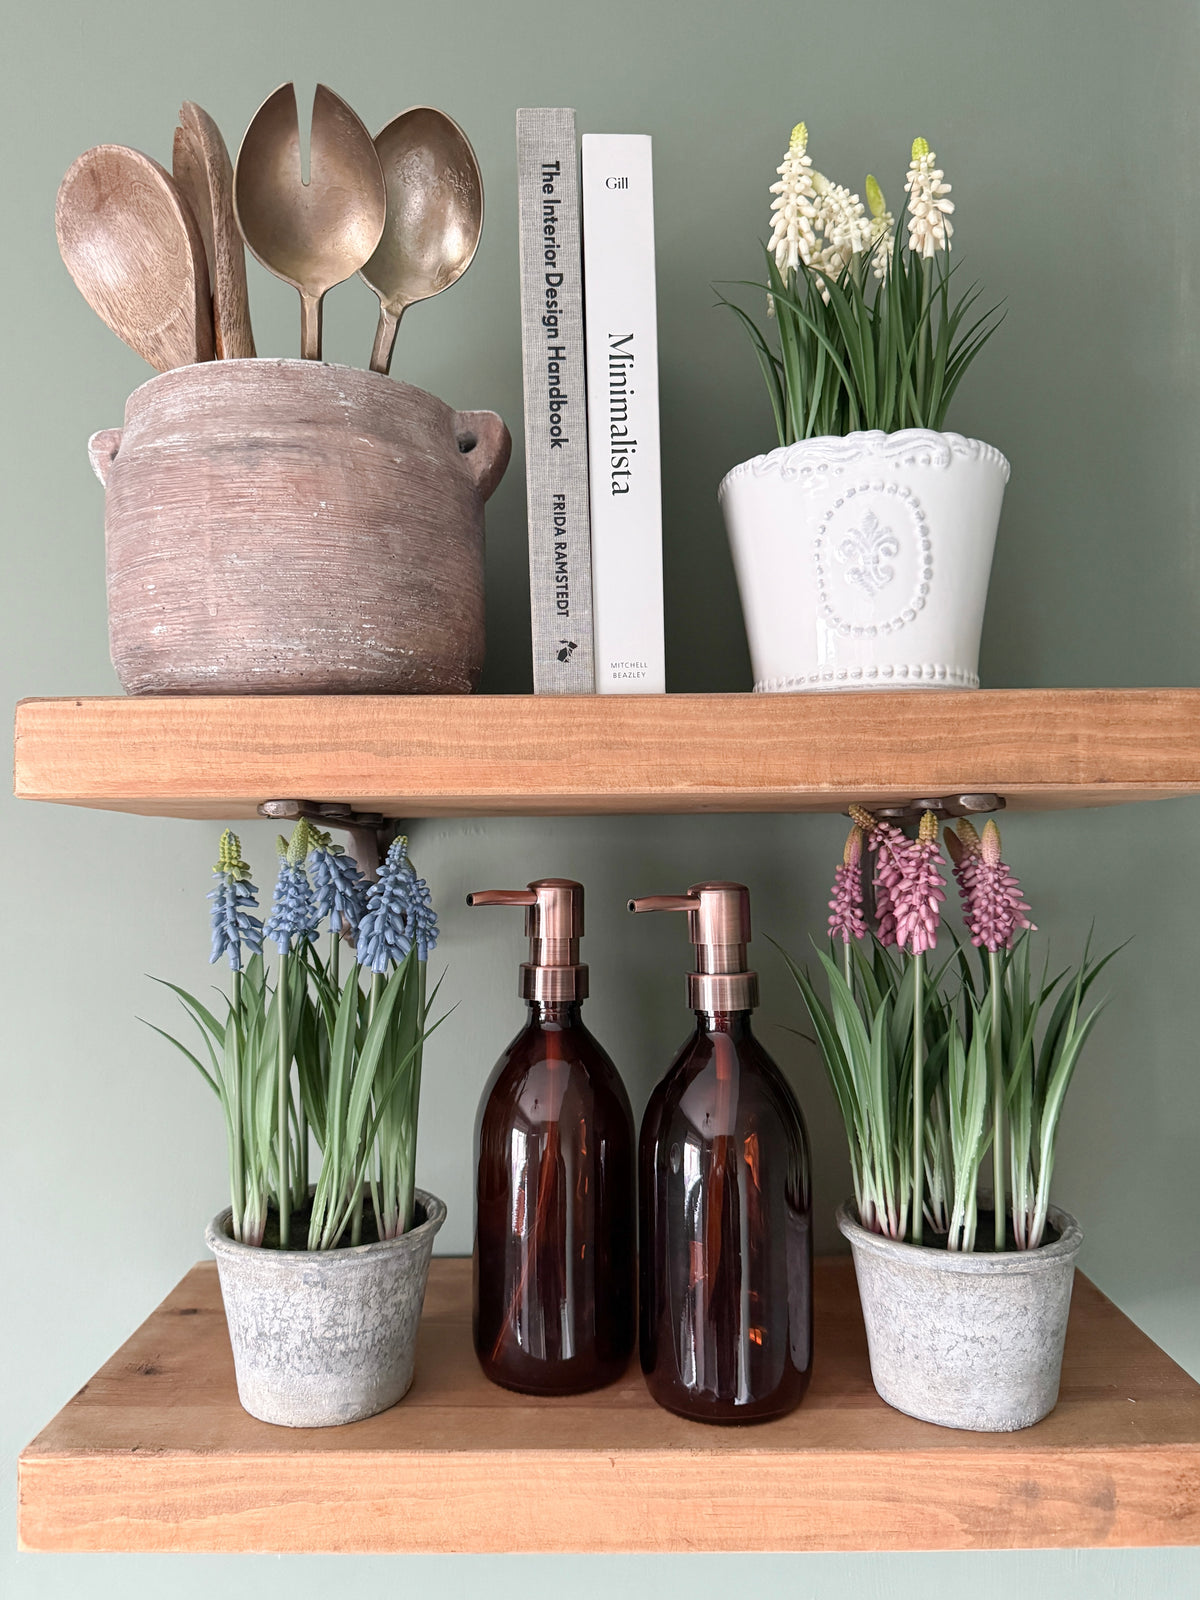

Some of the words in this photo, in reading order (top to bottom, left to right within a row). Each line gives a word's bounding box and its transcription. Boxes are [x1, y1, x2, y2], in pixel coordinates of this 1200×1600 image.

[541, 160, 560, 195] The
[605, 176, 629, 190] Gill
[542, 199, 562, 269] Interior
[541, 273, 564, 339] Design
[546, 346, 569, 450] Handbook
[608, 333, 638, 497] Minimalista
[552, 494, 567, 537] FRIDA
[554, 542, 570, 618] RAMSTEDT
[612, 671, 646, 679] BEAZLEY
